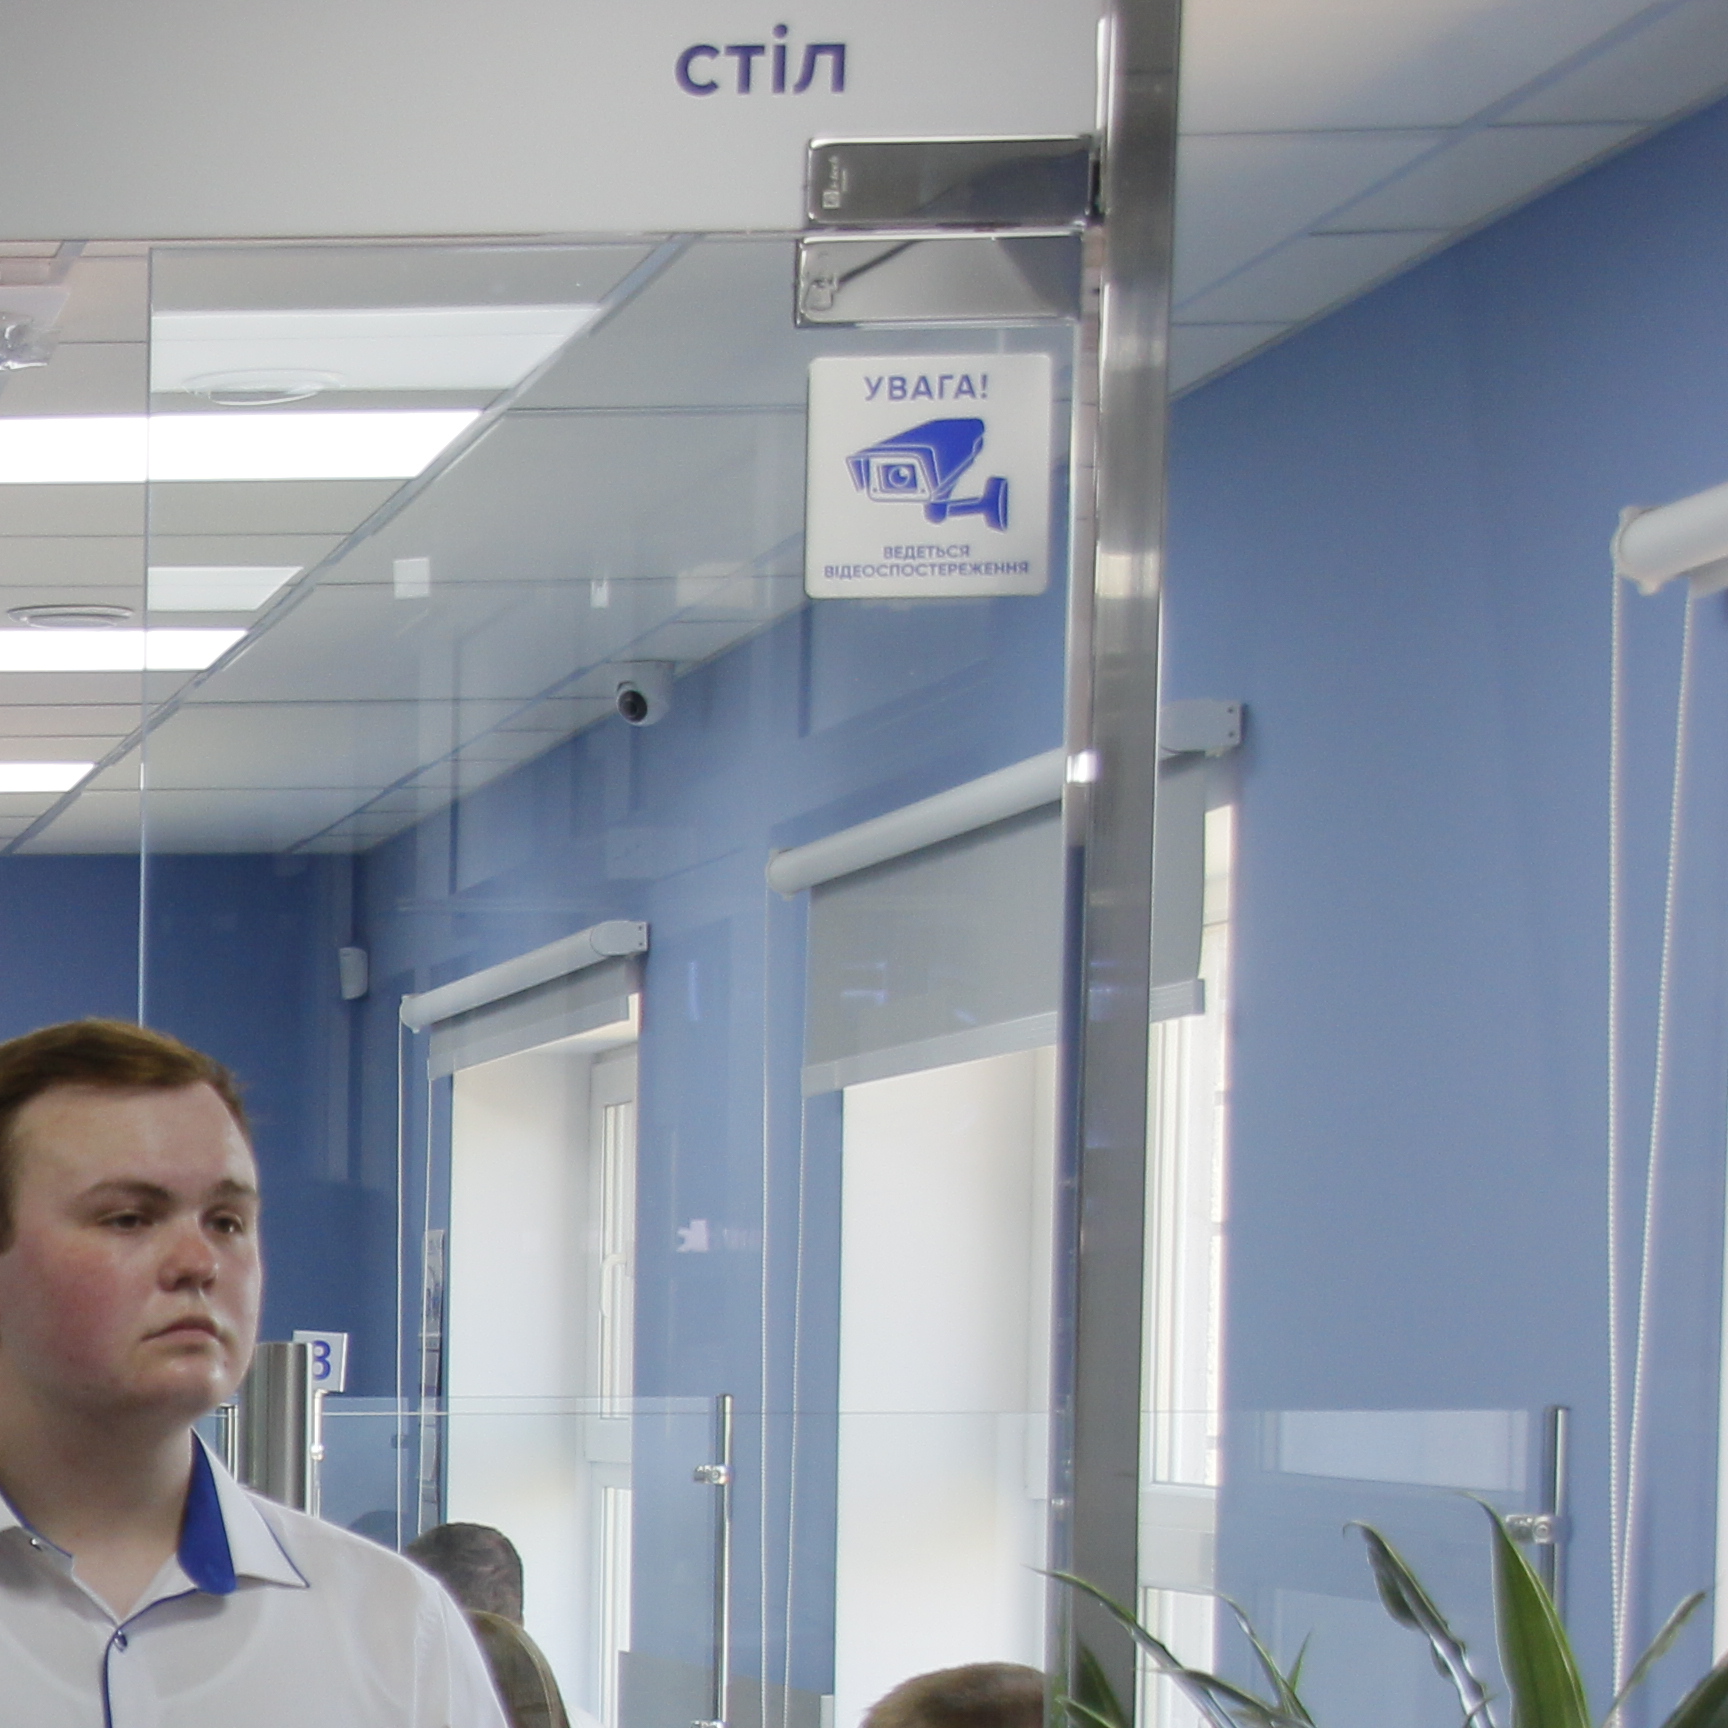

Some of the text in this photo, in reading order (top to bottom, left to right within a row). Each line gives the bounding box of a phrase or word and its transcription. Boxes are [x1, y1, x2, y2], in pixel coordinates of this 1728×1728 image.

[674, 23, 846, 97] стіл
[864, 373, 989, 401] УВАГА!
[883, 545, 970, 560] ВЕДЕТЬСЯ
[824, 560, 1029, 579] ВІДЕОСПОСТЕРЕЖЕННЯ
